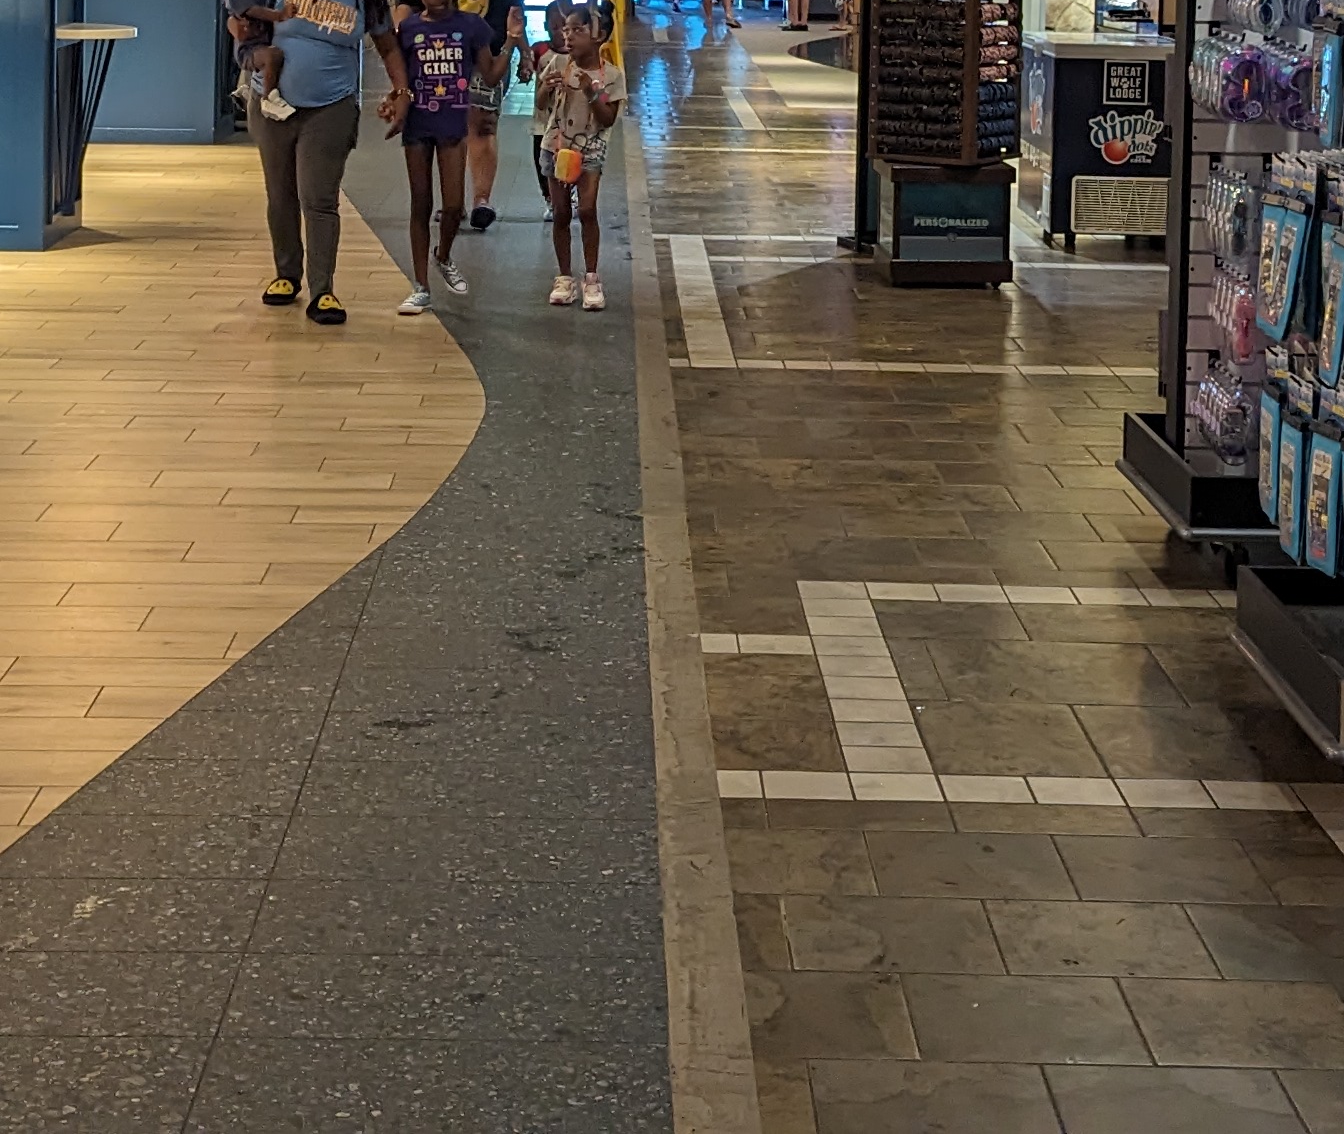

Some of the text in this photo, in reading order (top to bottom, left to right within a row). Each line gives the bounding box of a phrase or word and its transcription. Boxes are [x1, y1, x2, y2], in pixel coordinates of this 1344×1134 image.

[417, 47, 463, 61] GAMER
[423, 62, 458, 75] GIRL
[1110, 66, 1142, 77] GREAT
[1109, 87, 1142, 99] LODGE
[1129, 139, 1156, 156] dots
